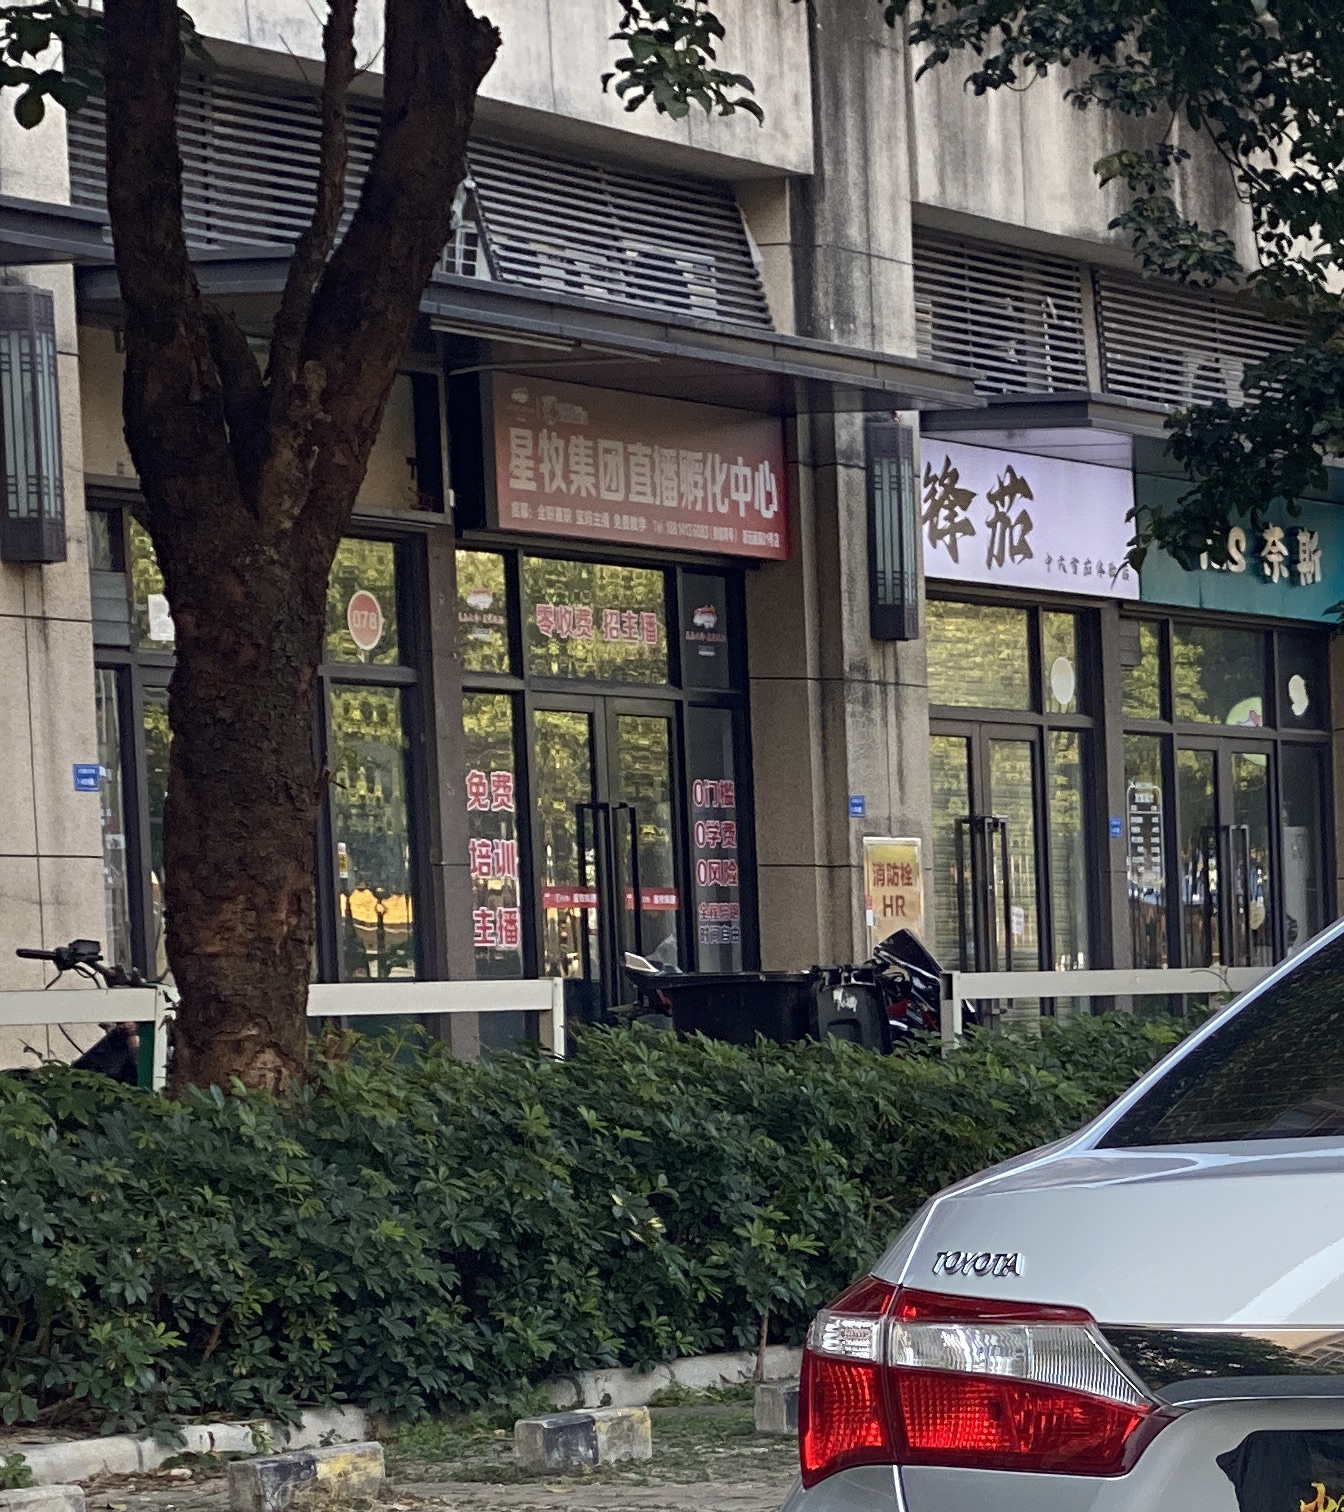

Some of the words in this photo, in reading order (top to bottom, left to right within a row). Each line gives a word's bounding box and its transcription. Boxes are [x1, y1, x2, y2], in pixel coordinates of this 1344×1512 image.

[509, 426, 779, 519] 星牧集团直播孵化中心
[536, 604, 593, 640] 零收费
[602, 608, 657, 645] 招主播
[465, 769, 514, 813] 免费
[693, 779, 736, 808] 0门槛
[695, 820, 738, 849] 0学费
[469, 838, 518, 880] 培训
[872, 862, 913, 887] 消防栓
[882, 894, 906, 917] HR
[472, 907, 521, 948] 主播
[932, 1250, 1025, 1277] TOYOTA
